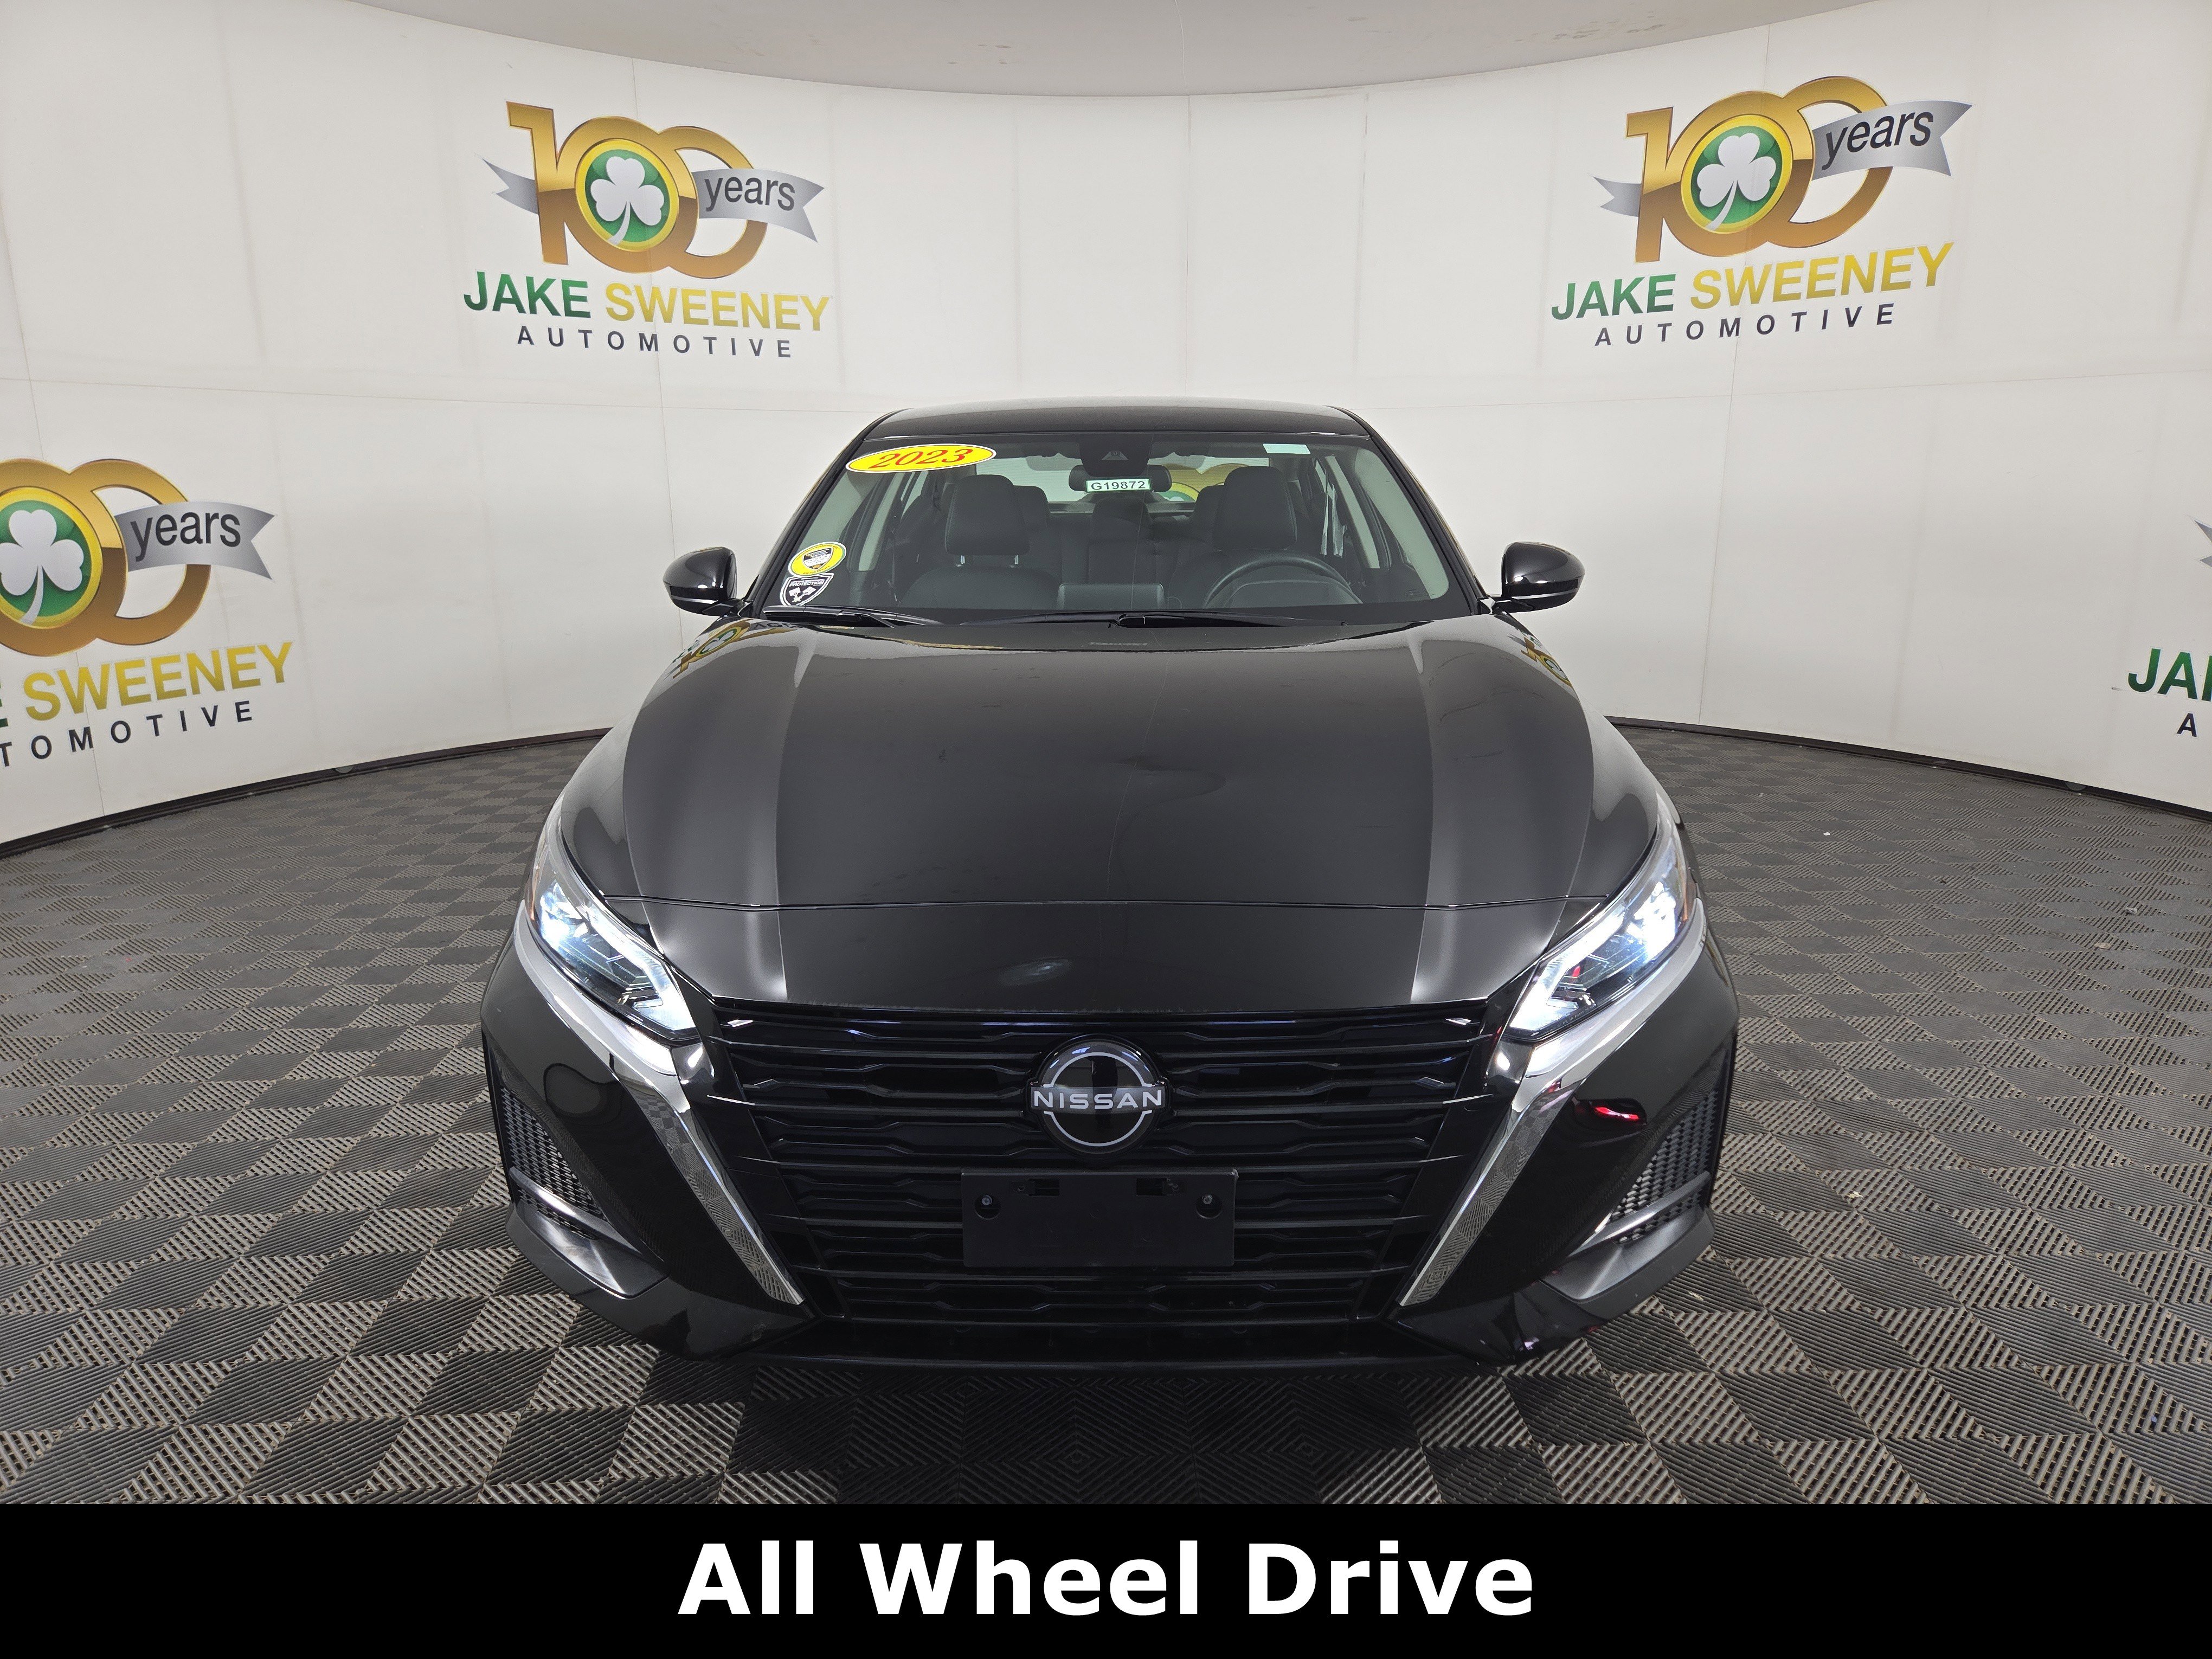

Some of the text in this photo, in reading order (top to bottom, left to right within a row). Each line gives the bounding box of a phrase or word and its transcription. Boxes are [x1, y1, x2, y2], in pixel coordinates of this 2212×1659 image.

[1822, 111, 1934, 171] years
[506, 101, 768, 279] 100
[705, 177, 796, 211] years
[1626, 75, 1893, 263] 100
[464, 271, 830, 331] JAKE SWEENEY
[1551, 242, 1954, 320] JAKE SWEENEY
[517, 325, 792, 358] AUTOMOTIVE
[1594, 303, 1894, 347] AUTOMOTIVE
[868, 448, 973, 469] 2023
[1091, 480, 1146, 491] G19872
[130, 512, 241, 562] years
[23, 642, 292, 721] SWEENEY
[2128, 648, 2212, 702] JA
[1034, 1090, 1162, 1110] NISSAN
